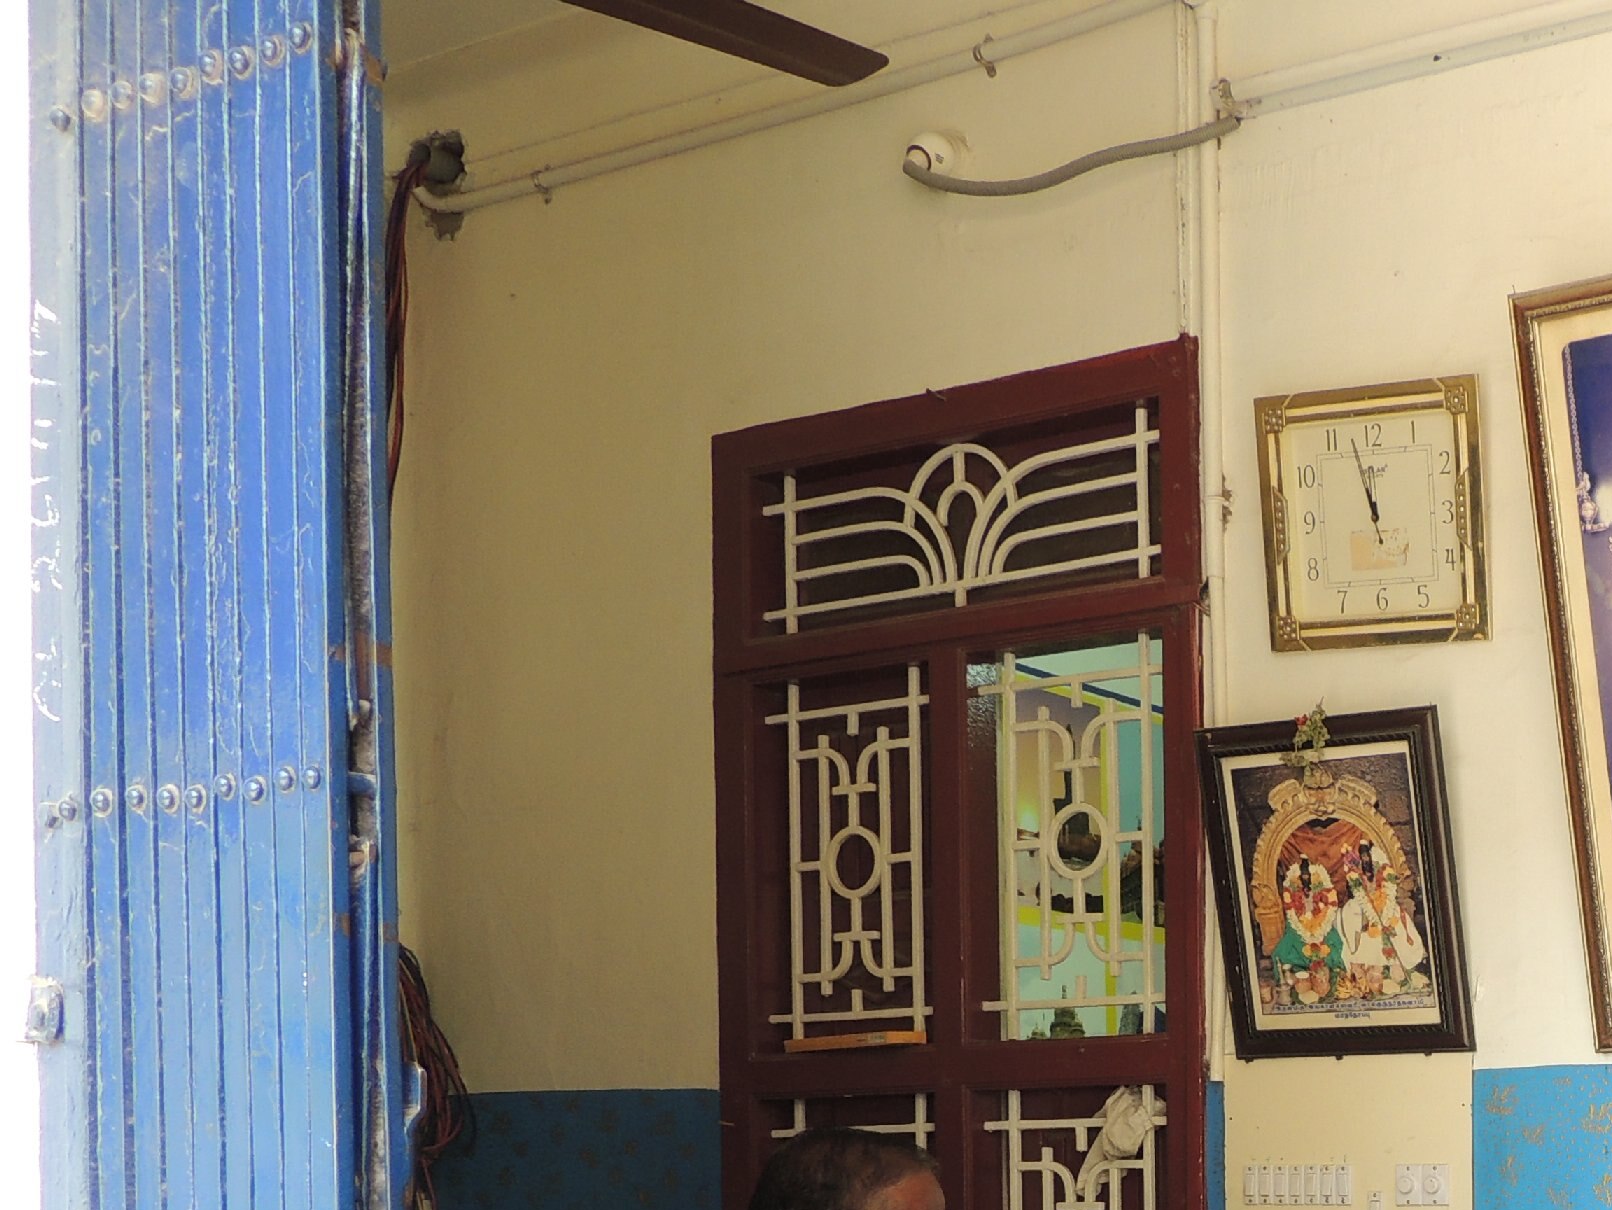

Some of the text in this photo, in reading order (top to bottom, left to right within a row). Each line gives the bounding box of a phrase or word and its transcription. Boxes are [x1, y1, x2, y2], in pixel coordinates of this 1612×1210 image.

[1326, 429, 1337, 451] 11
[1364, 423, 1382, 448] 12
[1410, 420, 1416, 444] 1
[1438, 451, 1450, 475] 2
[1297, 465, 1315, 488] 10
[1304, 511, 1315, 535] 9
[1442, 500, 1454, 524] 3
[1307, 558, 1319, 581] 8
[1445, 549, 1456, 571] 4
[1337, 590, 1348, 614] 7
[1376, 588, 1389, 610] 6
[1418, 585, 1429, 608] 5
